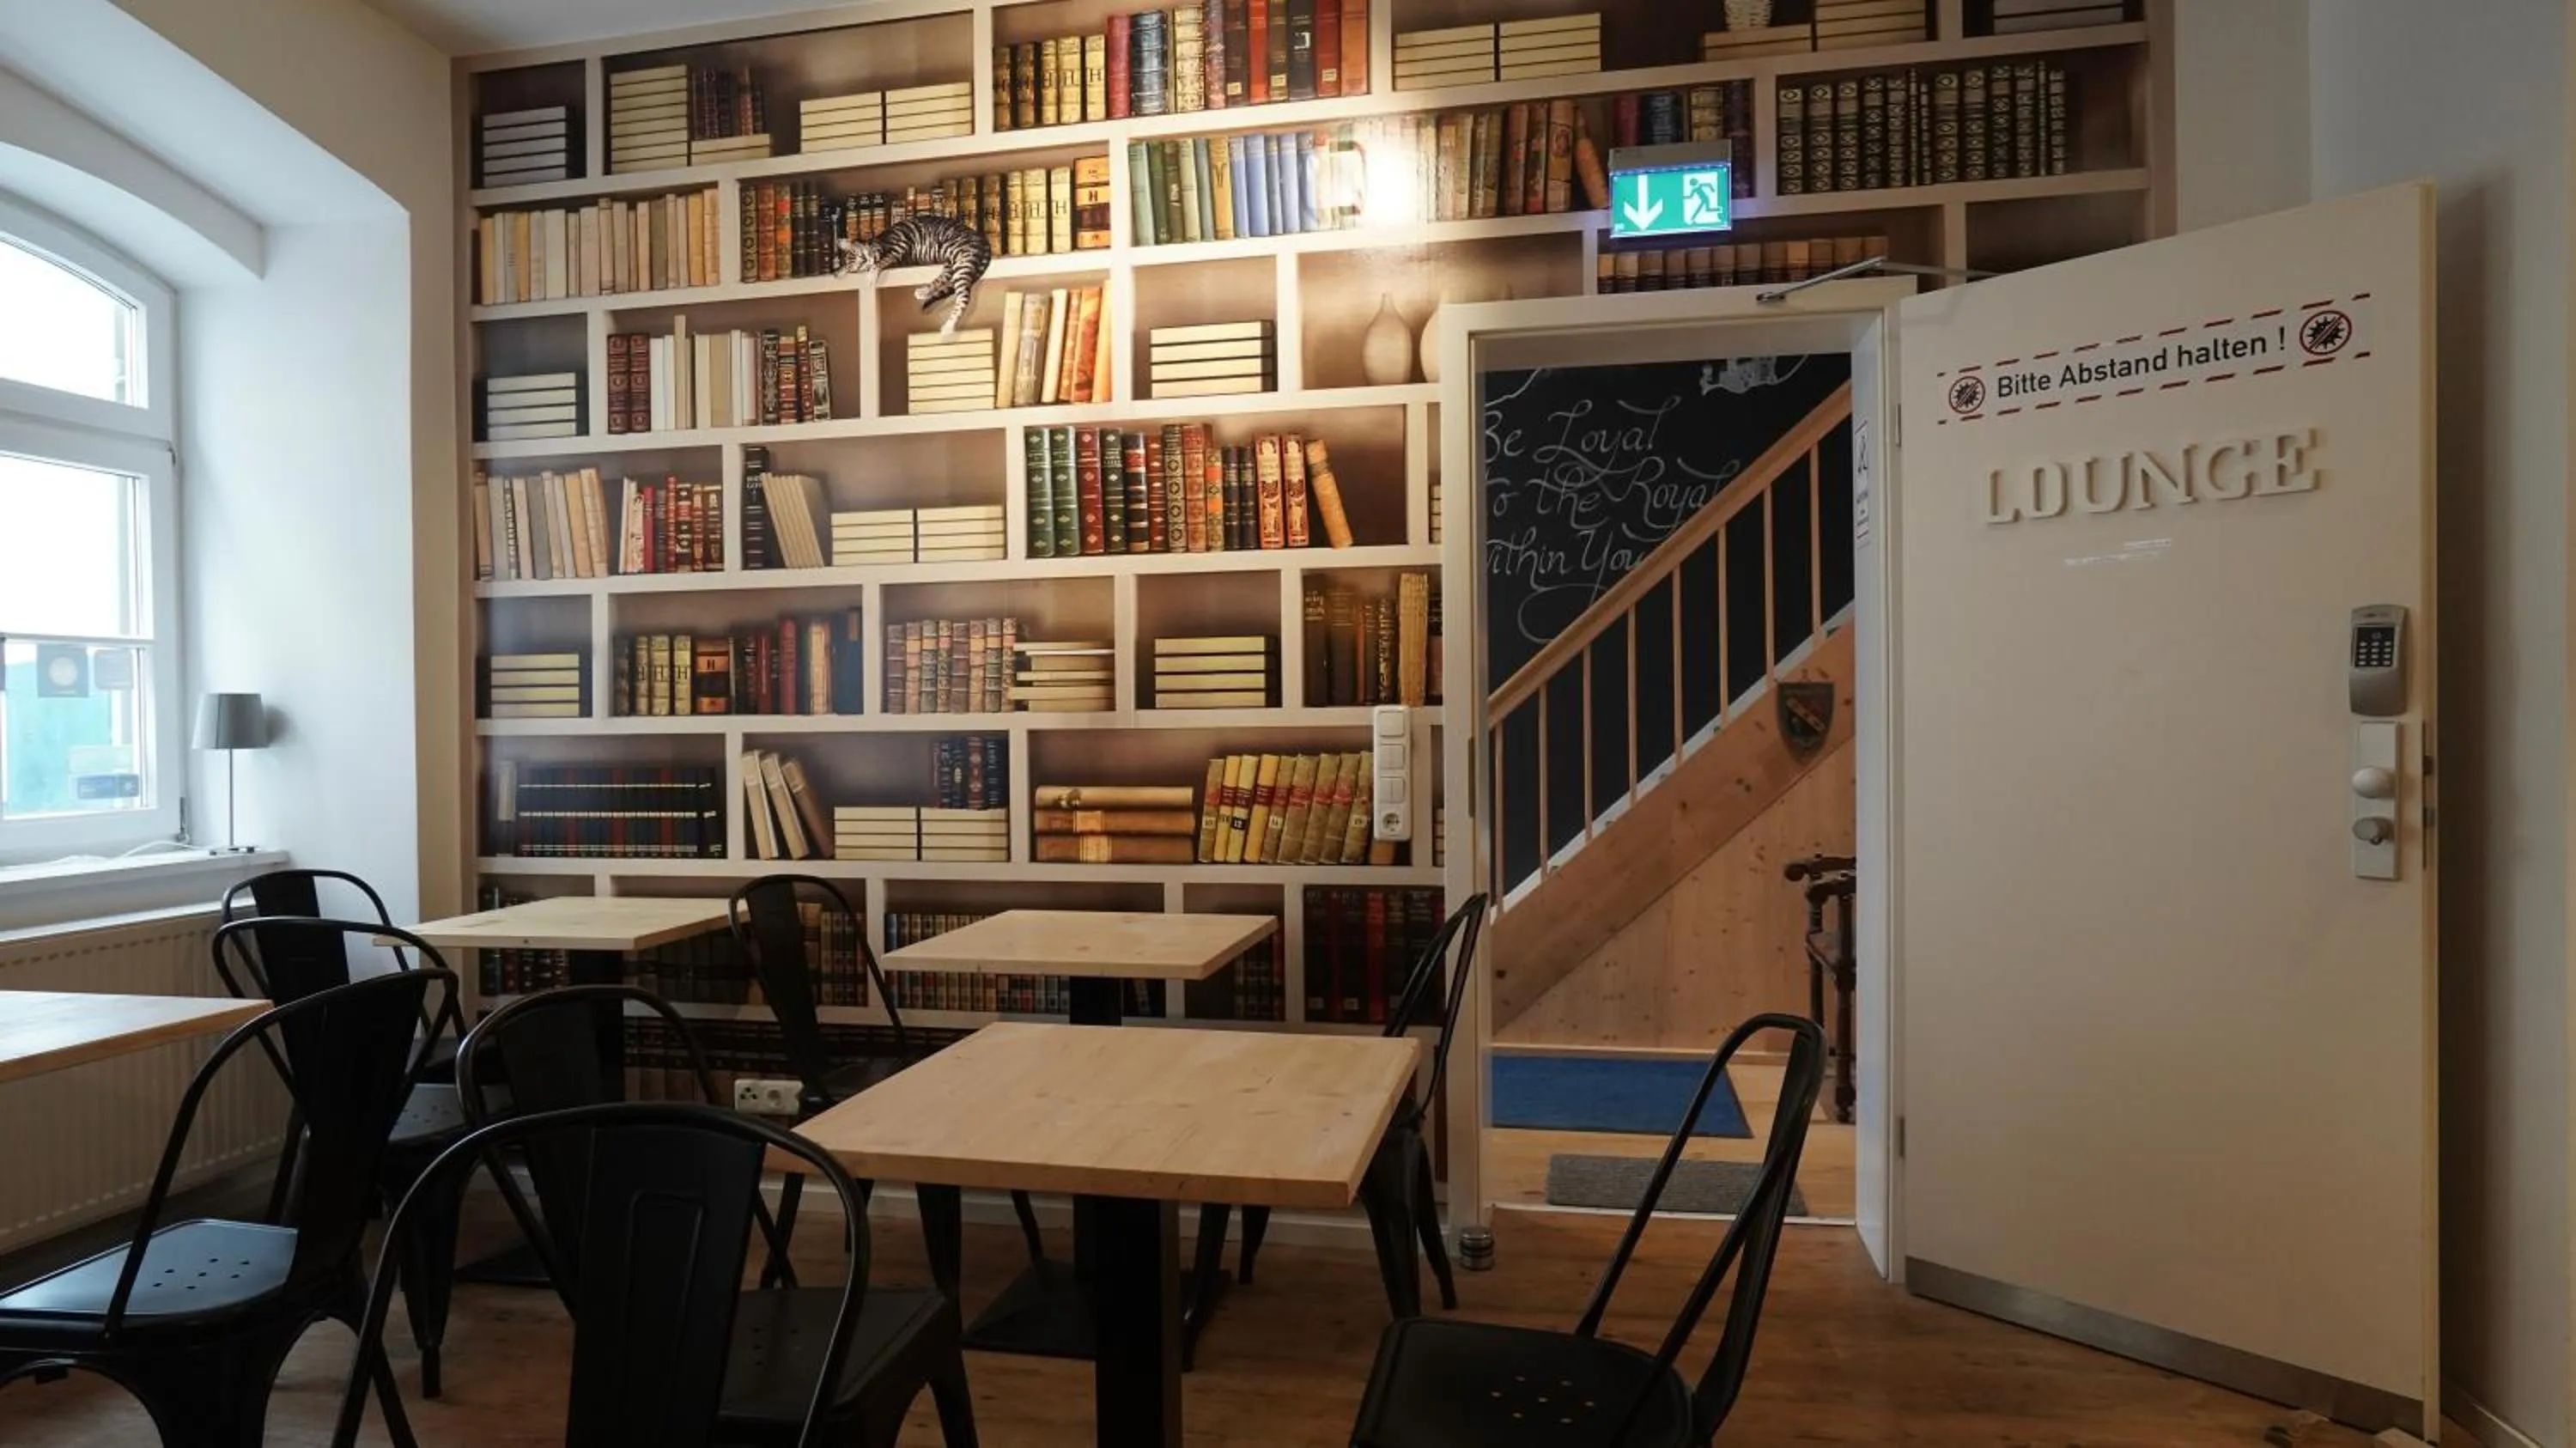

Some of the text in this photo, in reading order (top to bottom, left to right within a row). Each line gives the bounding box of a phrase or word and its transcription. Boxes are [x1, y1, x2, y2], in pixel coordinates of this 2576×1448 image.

[1997, 372, 2052, 399] Bitte
[2058, 347, 2168, 388] Abstand
[2177, 336, 2268, 368] halten
[1987, 428, 2325, 526] LOUNGE
[1486, 526, 1573, 590] ithin
